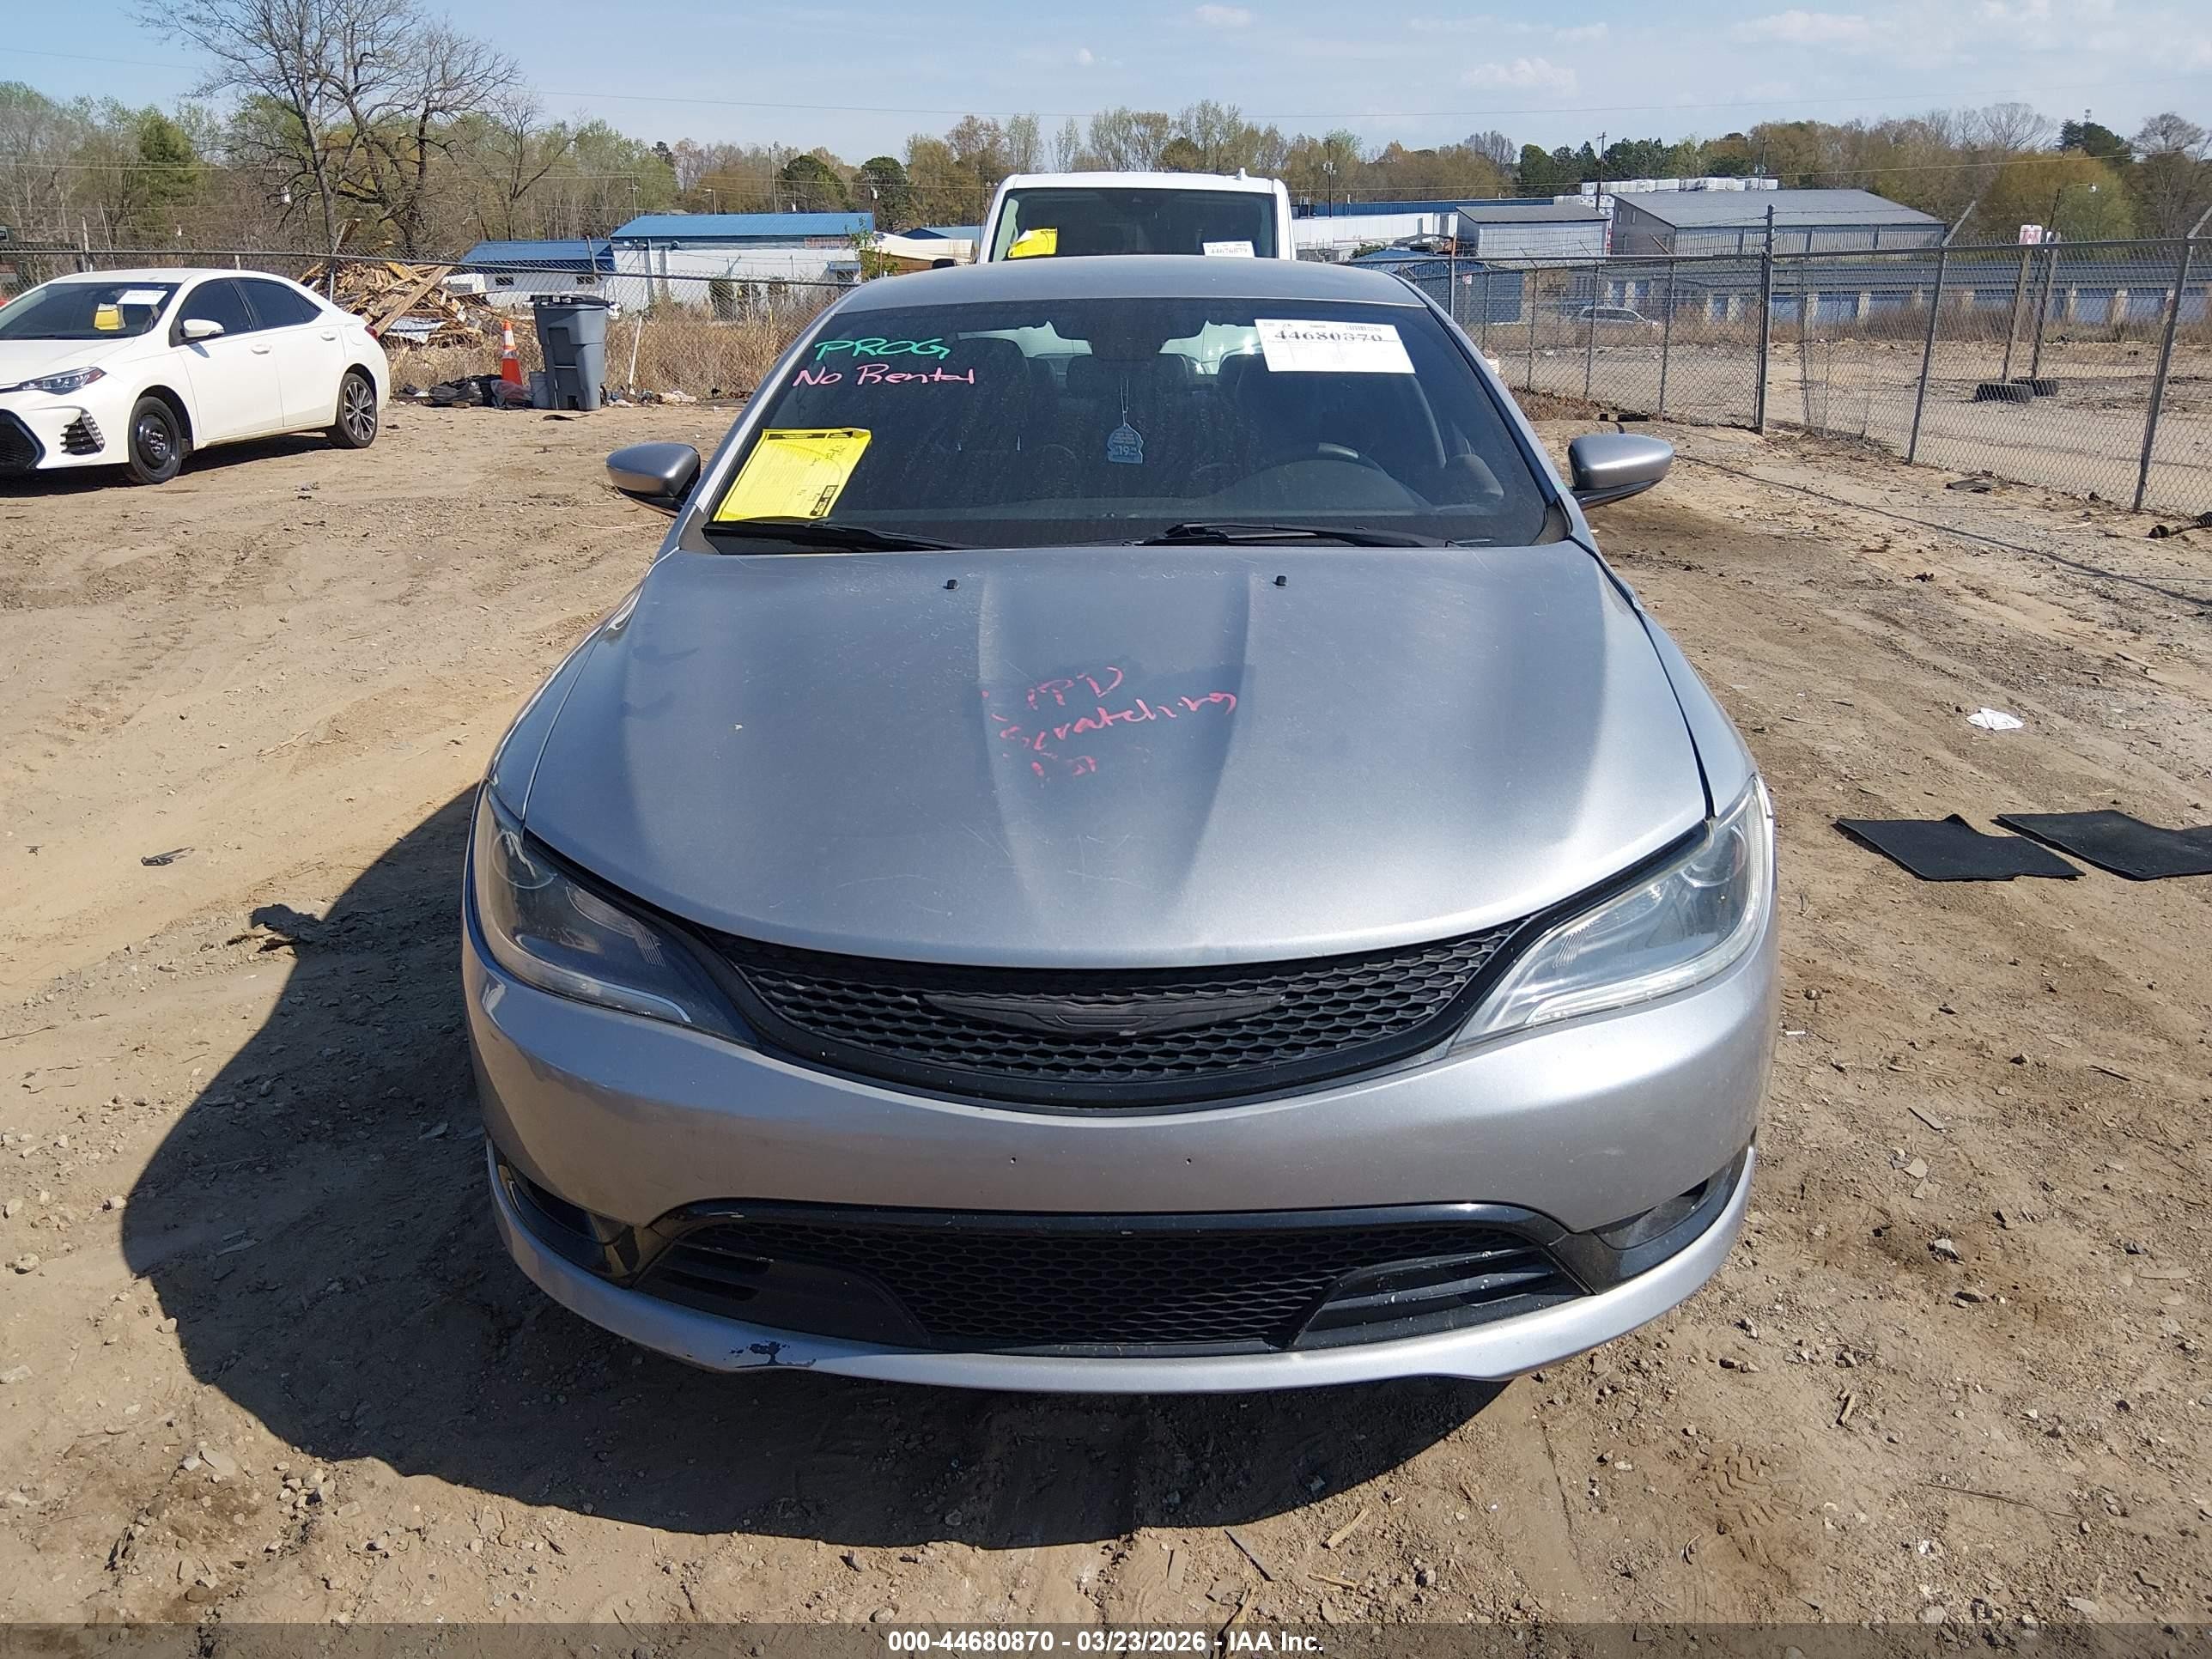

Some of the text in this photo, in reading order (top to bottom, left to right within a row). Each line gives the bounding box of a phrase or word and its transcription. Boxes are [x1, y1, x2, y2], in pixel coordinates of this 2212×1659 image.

[814, 337, 951, 361] PROG
[792, 363, 975, 387] No Rental
